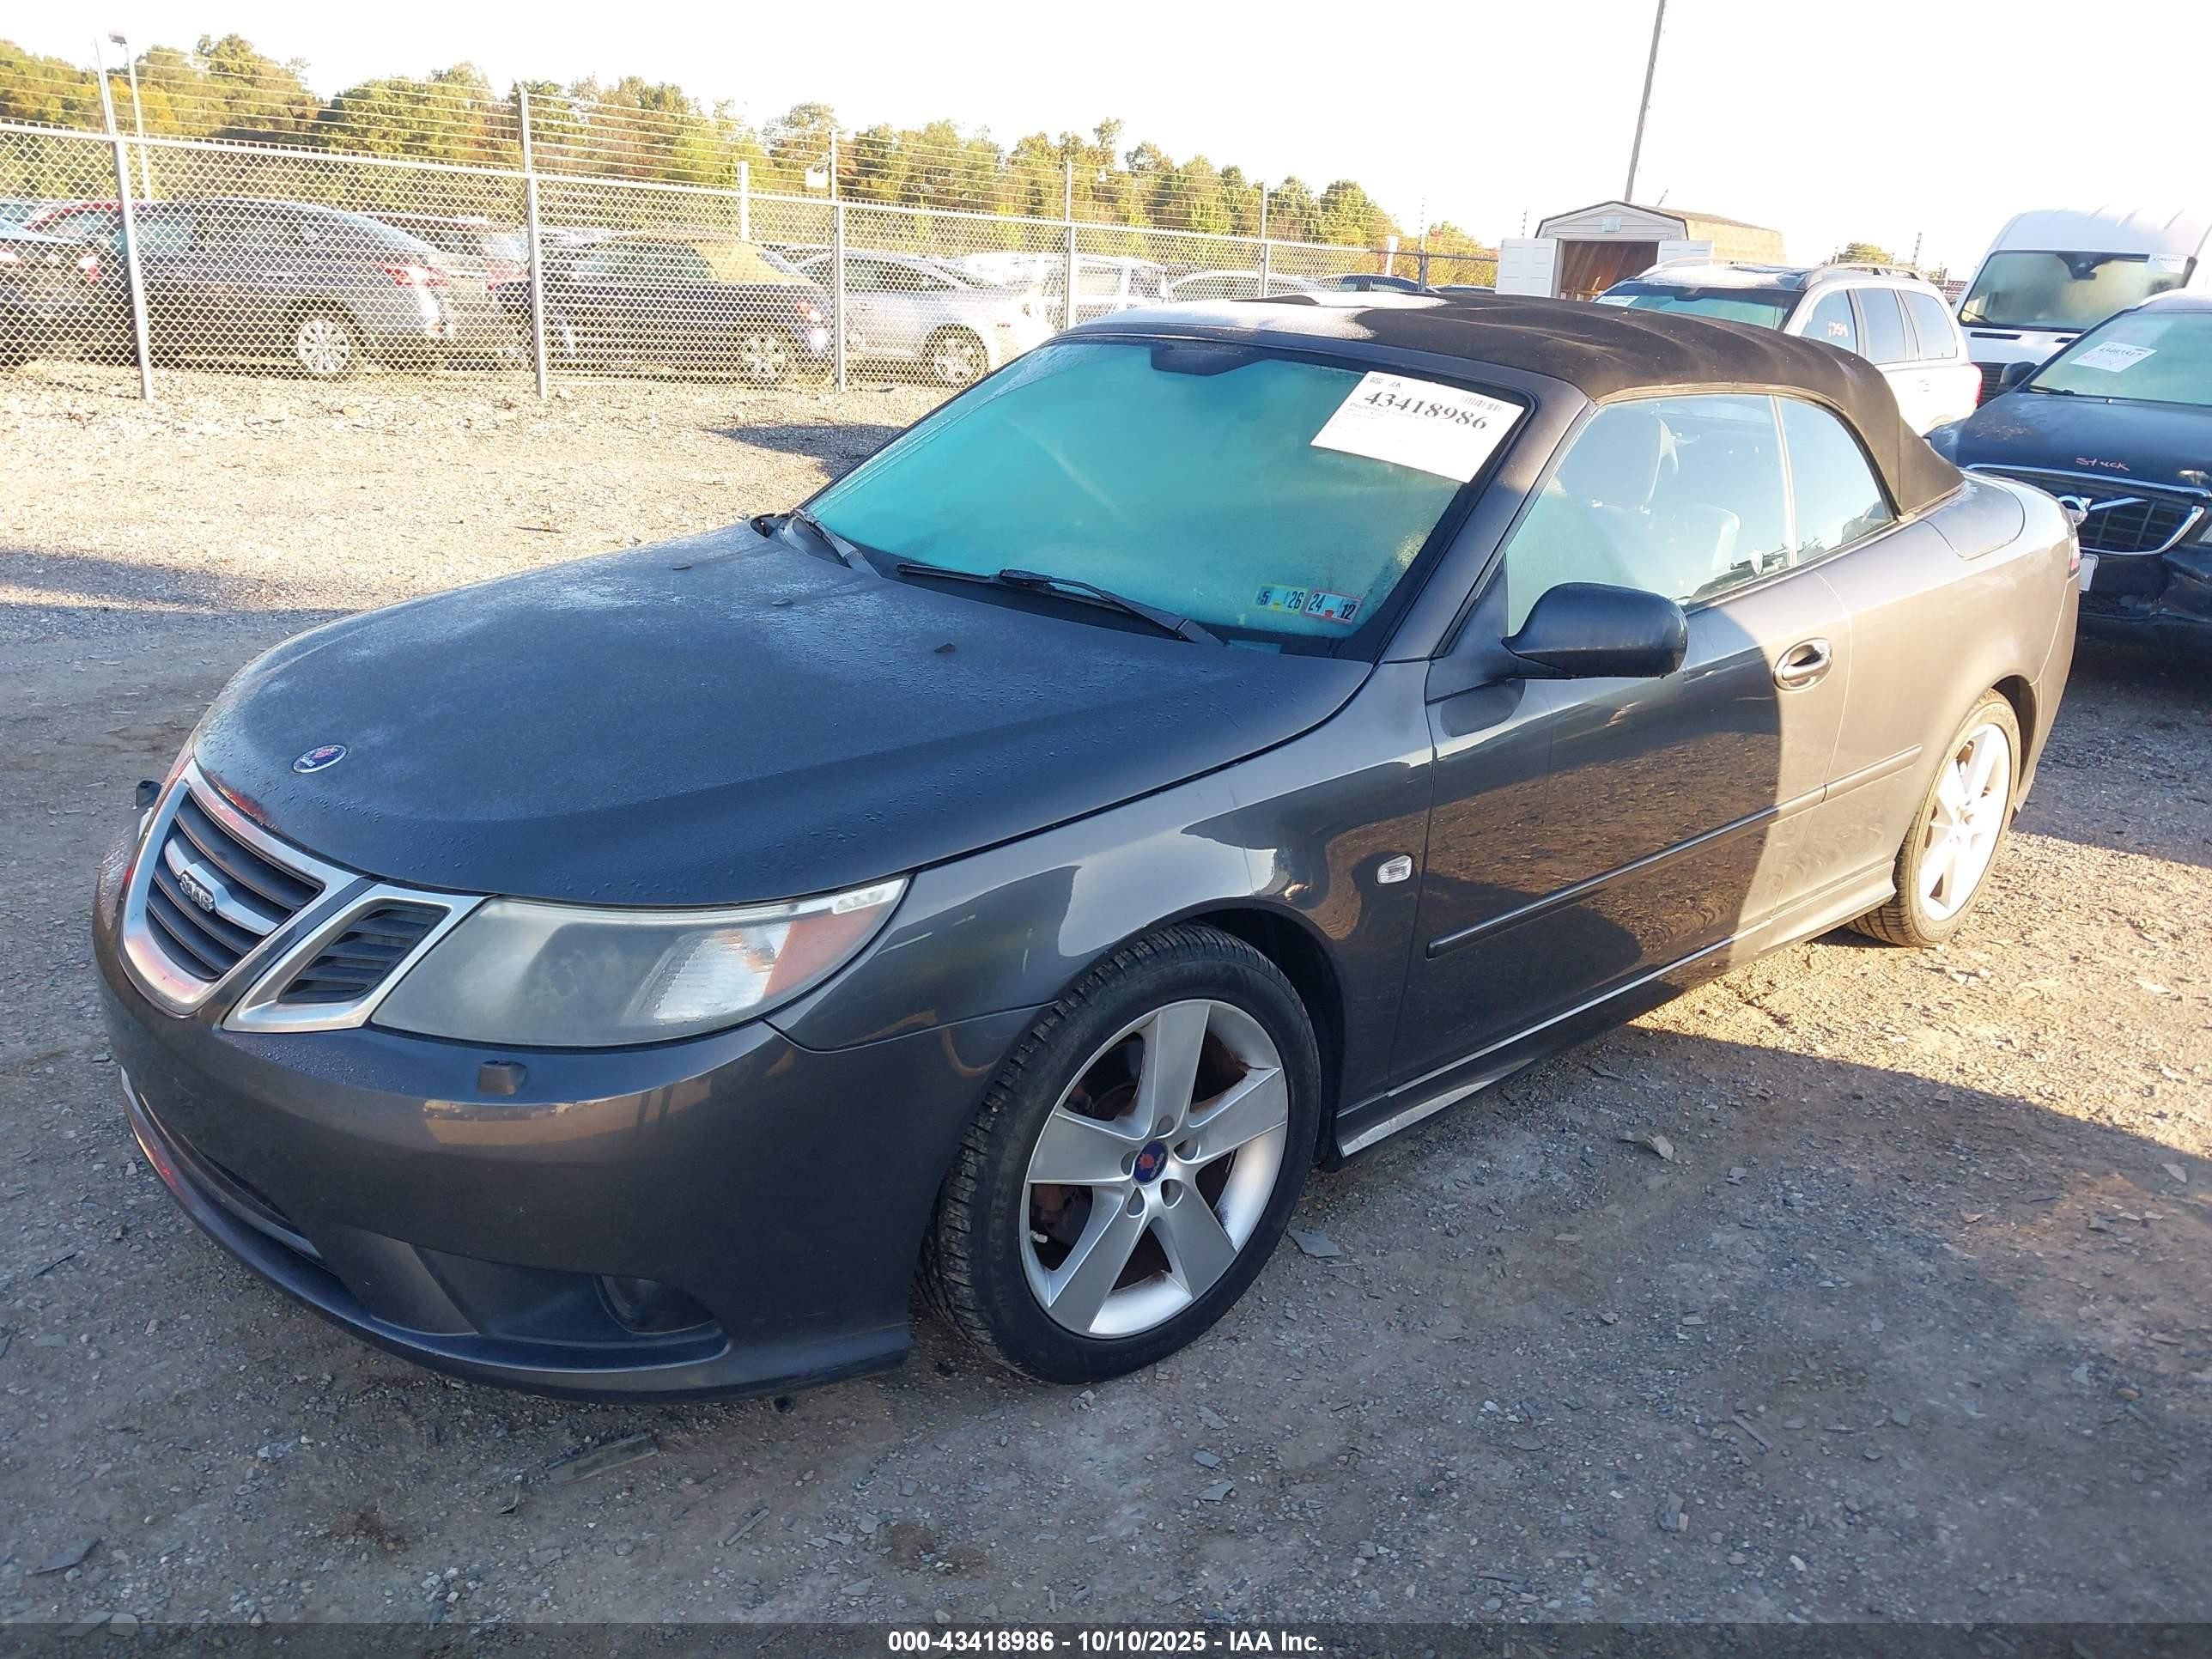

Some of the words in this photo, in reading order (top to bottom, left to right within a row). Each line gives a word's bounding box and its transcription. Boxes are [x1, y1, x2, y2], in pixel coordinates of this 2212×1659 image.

[1364, 391, 1488, 429] 43418986
[1287, 590, 1304, 610] 26
[1307, 592, 1327, 612] 24
[1340, 603, 1357, 620] 12
